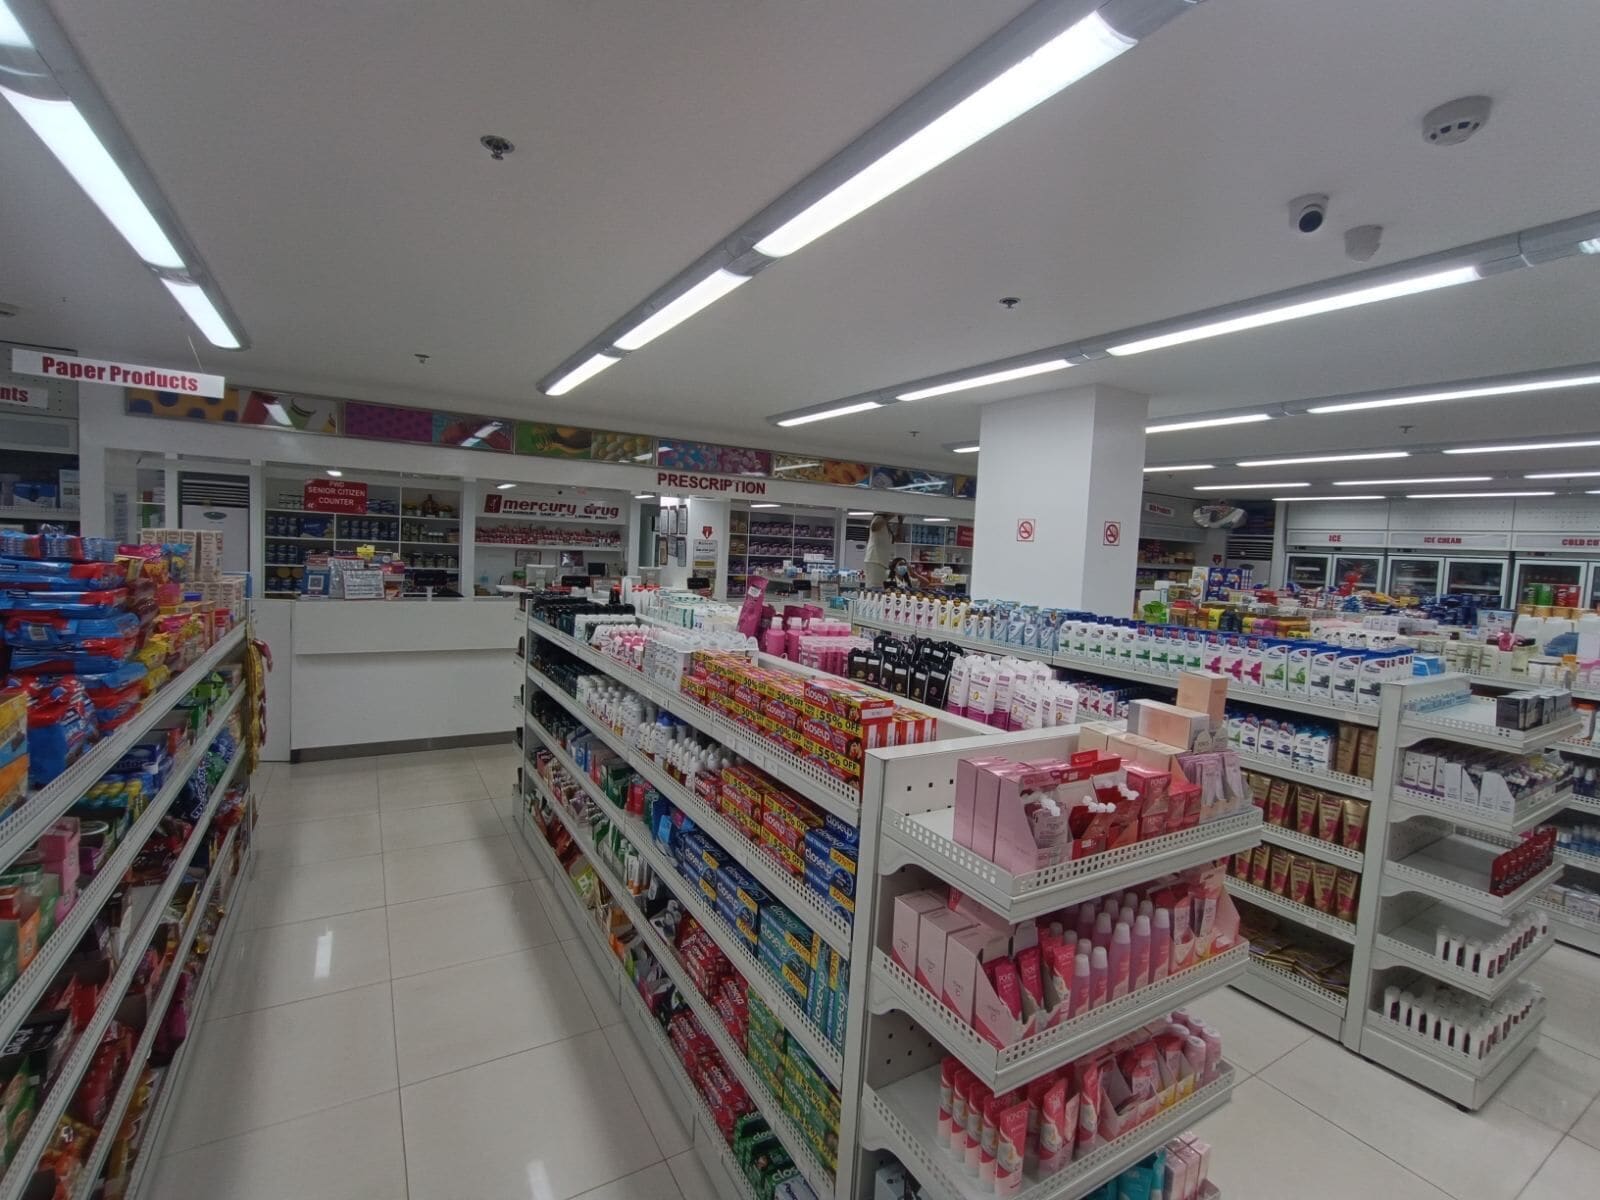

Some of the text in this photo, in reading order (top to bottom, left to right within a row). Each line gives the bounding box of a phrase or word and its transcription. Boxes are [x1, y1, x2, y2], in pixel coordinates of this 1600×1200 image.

[42, 356, 198, 391] Paper Products
[308, 486, 365, 496] SENIOR CITIZEN
[657, 472, 766, 494] PRESCRIPTION
[319, 497, 354, 506] COUNTER
[503, 499, 576, 515] mercury
[583, 503, 619, 519] drug
[1328, 534, 1341, 542] ICE
[804, 687, 829, 707] closeup
[766, 703, 786, 720] closeup
[820, 711, 860, 733] 55% OFF
[803, 719, 830, 743] closeup
[818, 747, 857, 770] 55% OFF
[826, 814, 853, 839] closeup
[805, 847, 832, 875] closeup
